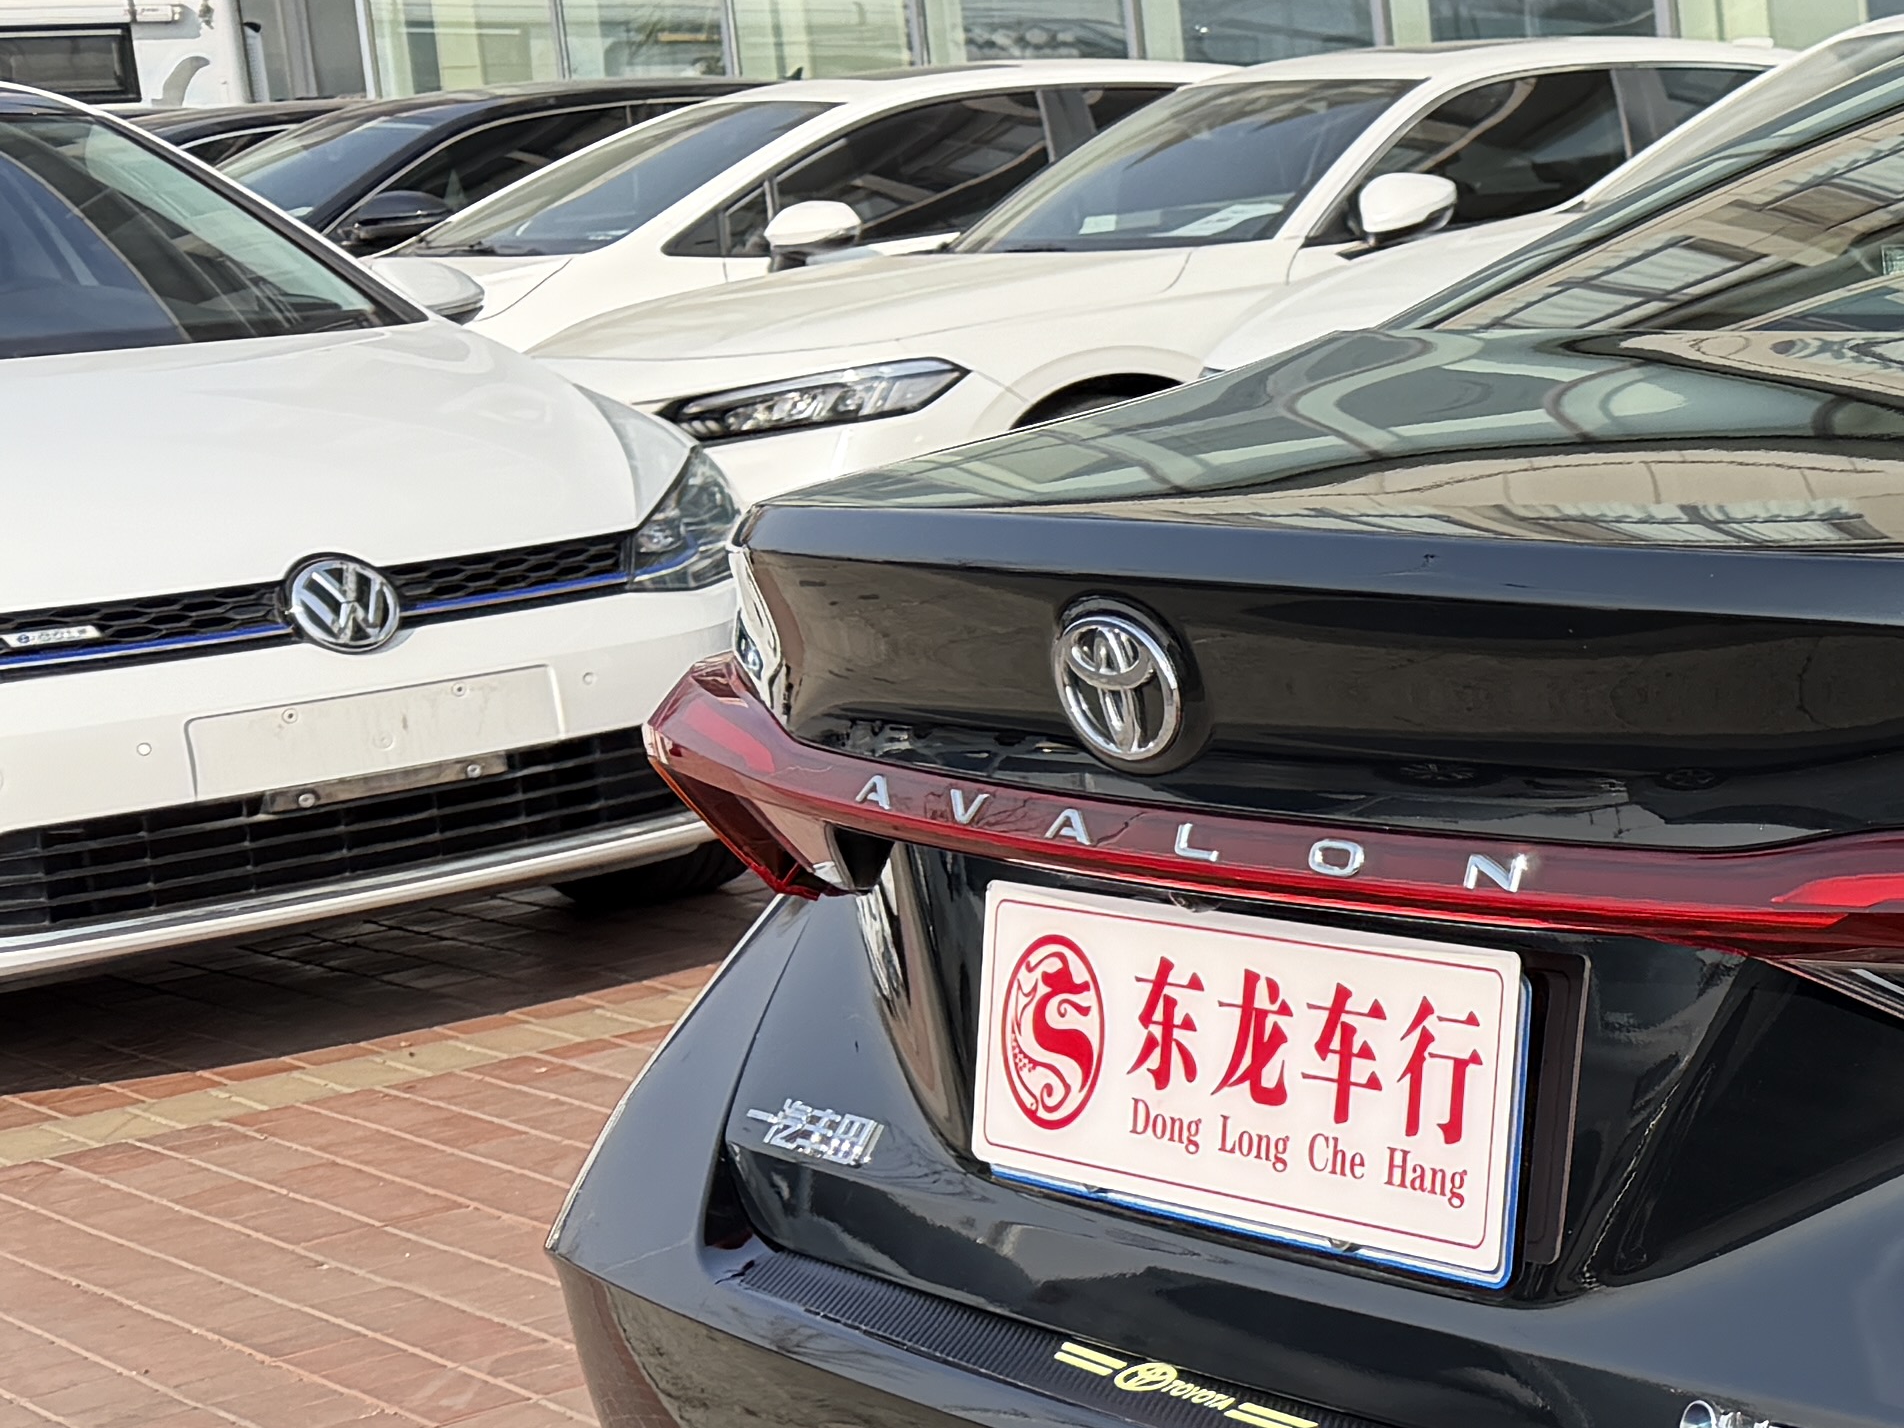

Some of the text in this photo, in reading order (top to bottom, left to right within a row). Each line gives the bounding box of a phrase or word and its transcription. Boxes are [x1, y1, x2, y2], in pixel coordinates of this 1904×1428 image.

[855, 774, 1529, 893] AVALON
[1126, 956, 1482, 1144] 东龙车行
[1129, 1097, 1468, 1209] Dong Long Che Hang
[1161, 1379, 1236, 1410] TOYOTA
